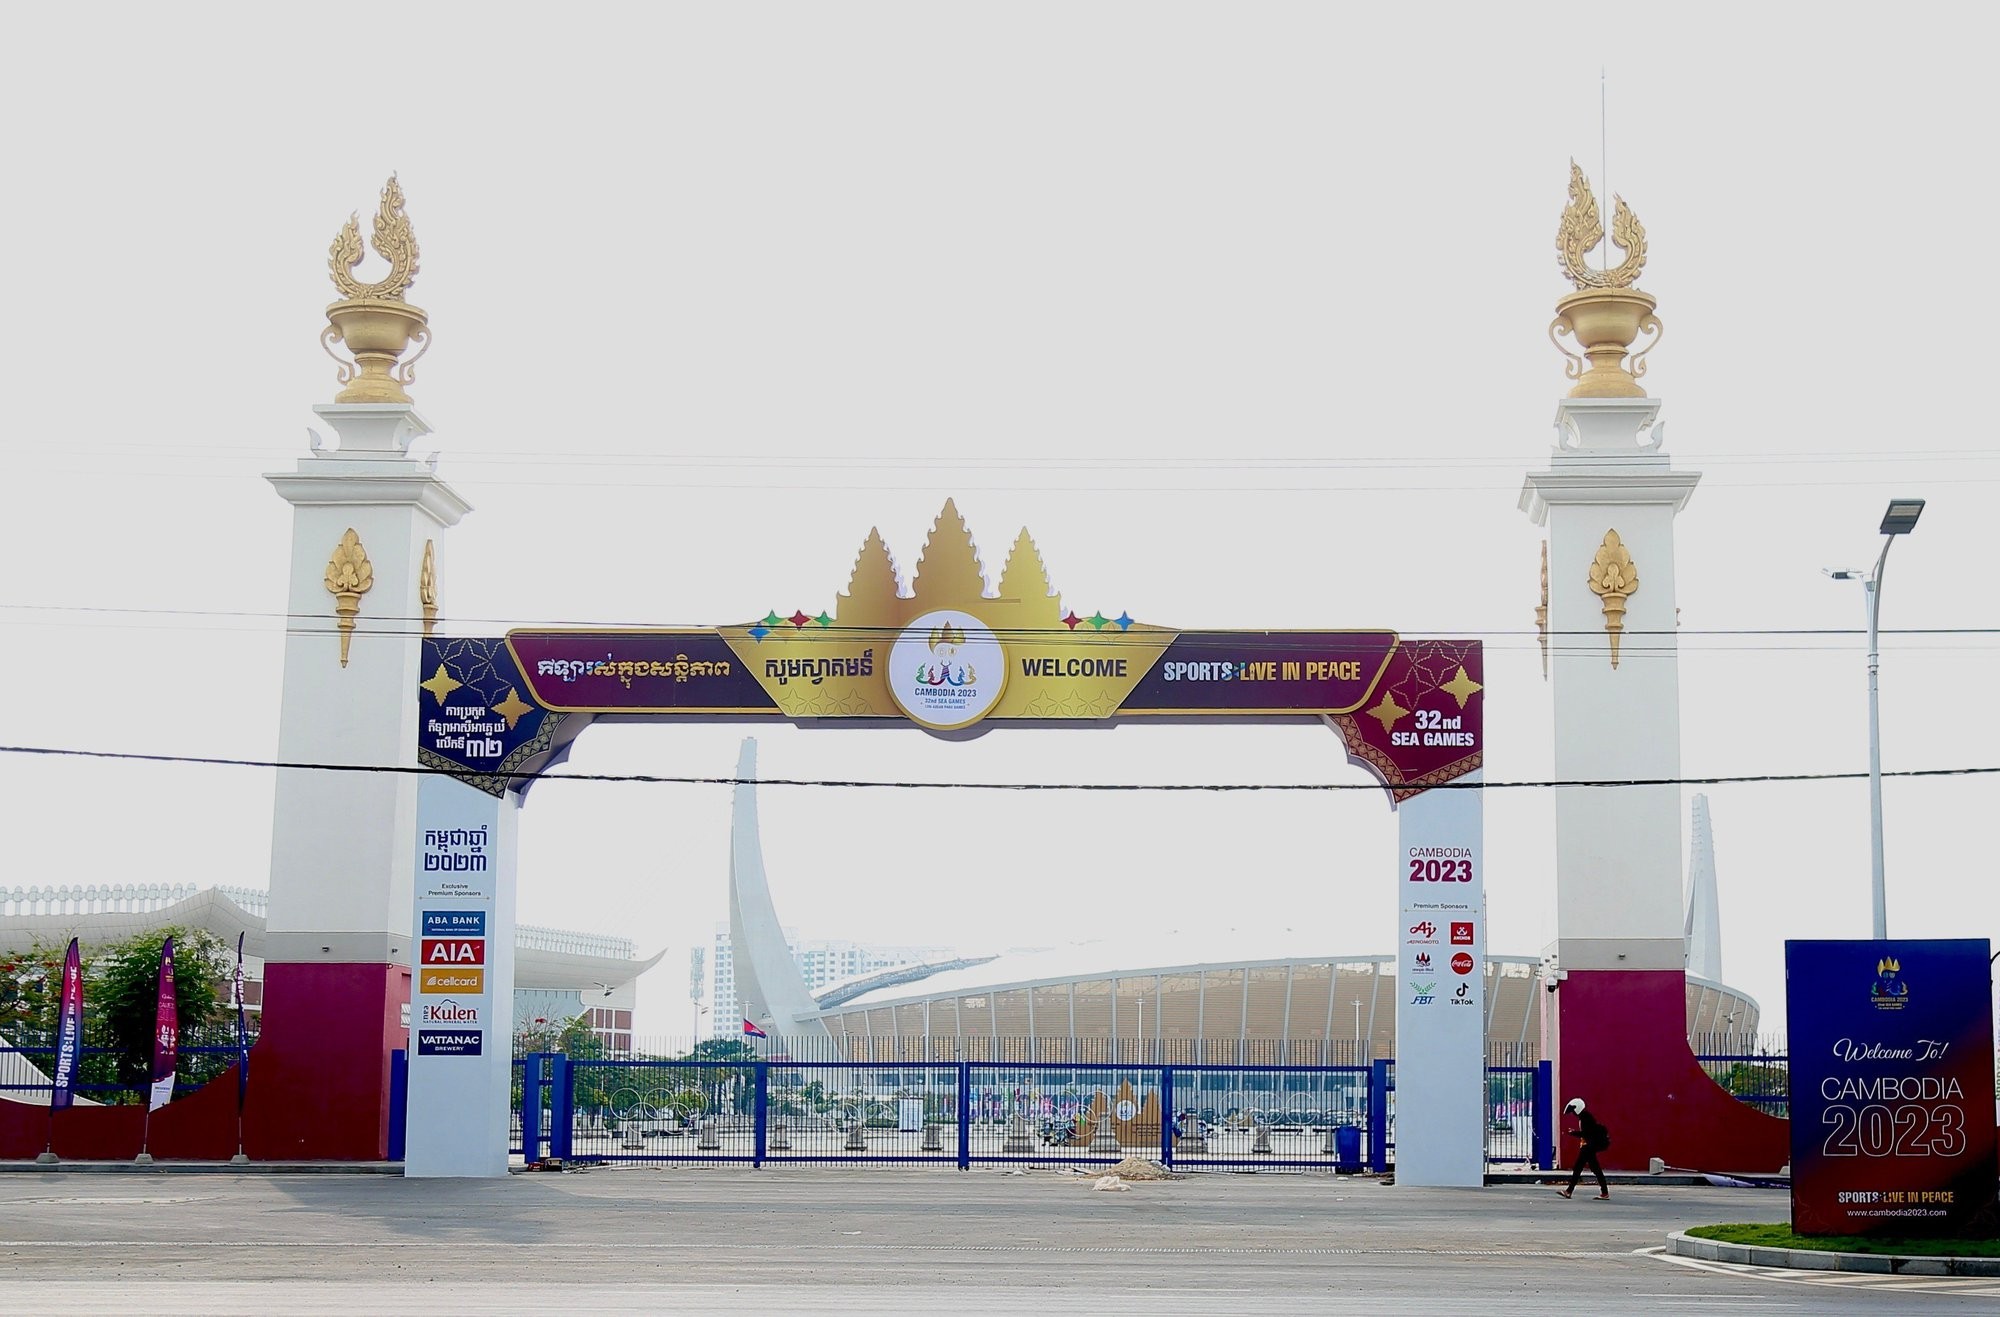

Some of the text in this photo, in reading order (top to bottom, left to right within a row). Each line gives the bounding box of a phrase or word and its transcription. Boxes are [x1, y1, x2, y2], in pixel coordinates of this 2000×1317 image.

[1022, 658, 1127, 677] WELCOME
[1283, 661, 1300, 681] IN
[1306, 661, 1360, 681] PEACE
[914, 687, 977, 698] CAMBODIA 2023
[1415, 709, 1462, 730] 32nd
[1391, 731, 1475, 746] SEA GAMES
[1409, 847, 1472, 858] CAMBODIA
[1409, 859, 1473, 882] 2023
[427, 916, 480, 925] ABA BANK
[429, 943, 476, 962] AIA
[437, 976, 478, 987] cellcard
[430, 1004, 477, 1020] Kulen
[420, 1035, 480, 1045] VATTANAC
[1833, 1037, 1950, 1062] Welcome To!
[1821, 1076, 1964, 1101] CAMBODIA
[1822, 1104, 1967, 1158] 2023
[1907, 1191, 1919, 1203] IN
[1921, 1191, 1954, 1203] PEACE
[1847, 1208, 1947, 1217] www.cambodia2023.com
